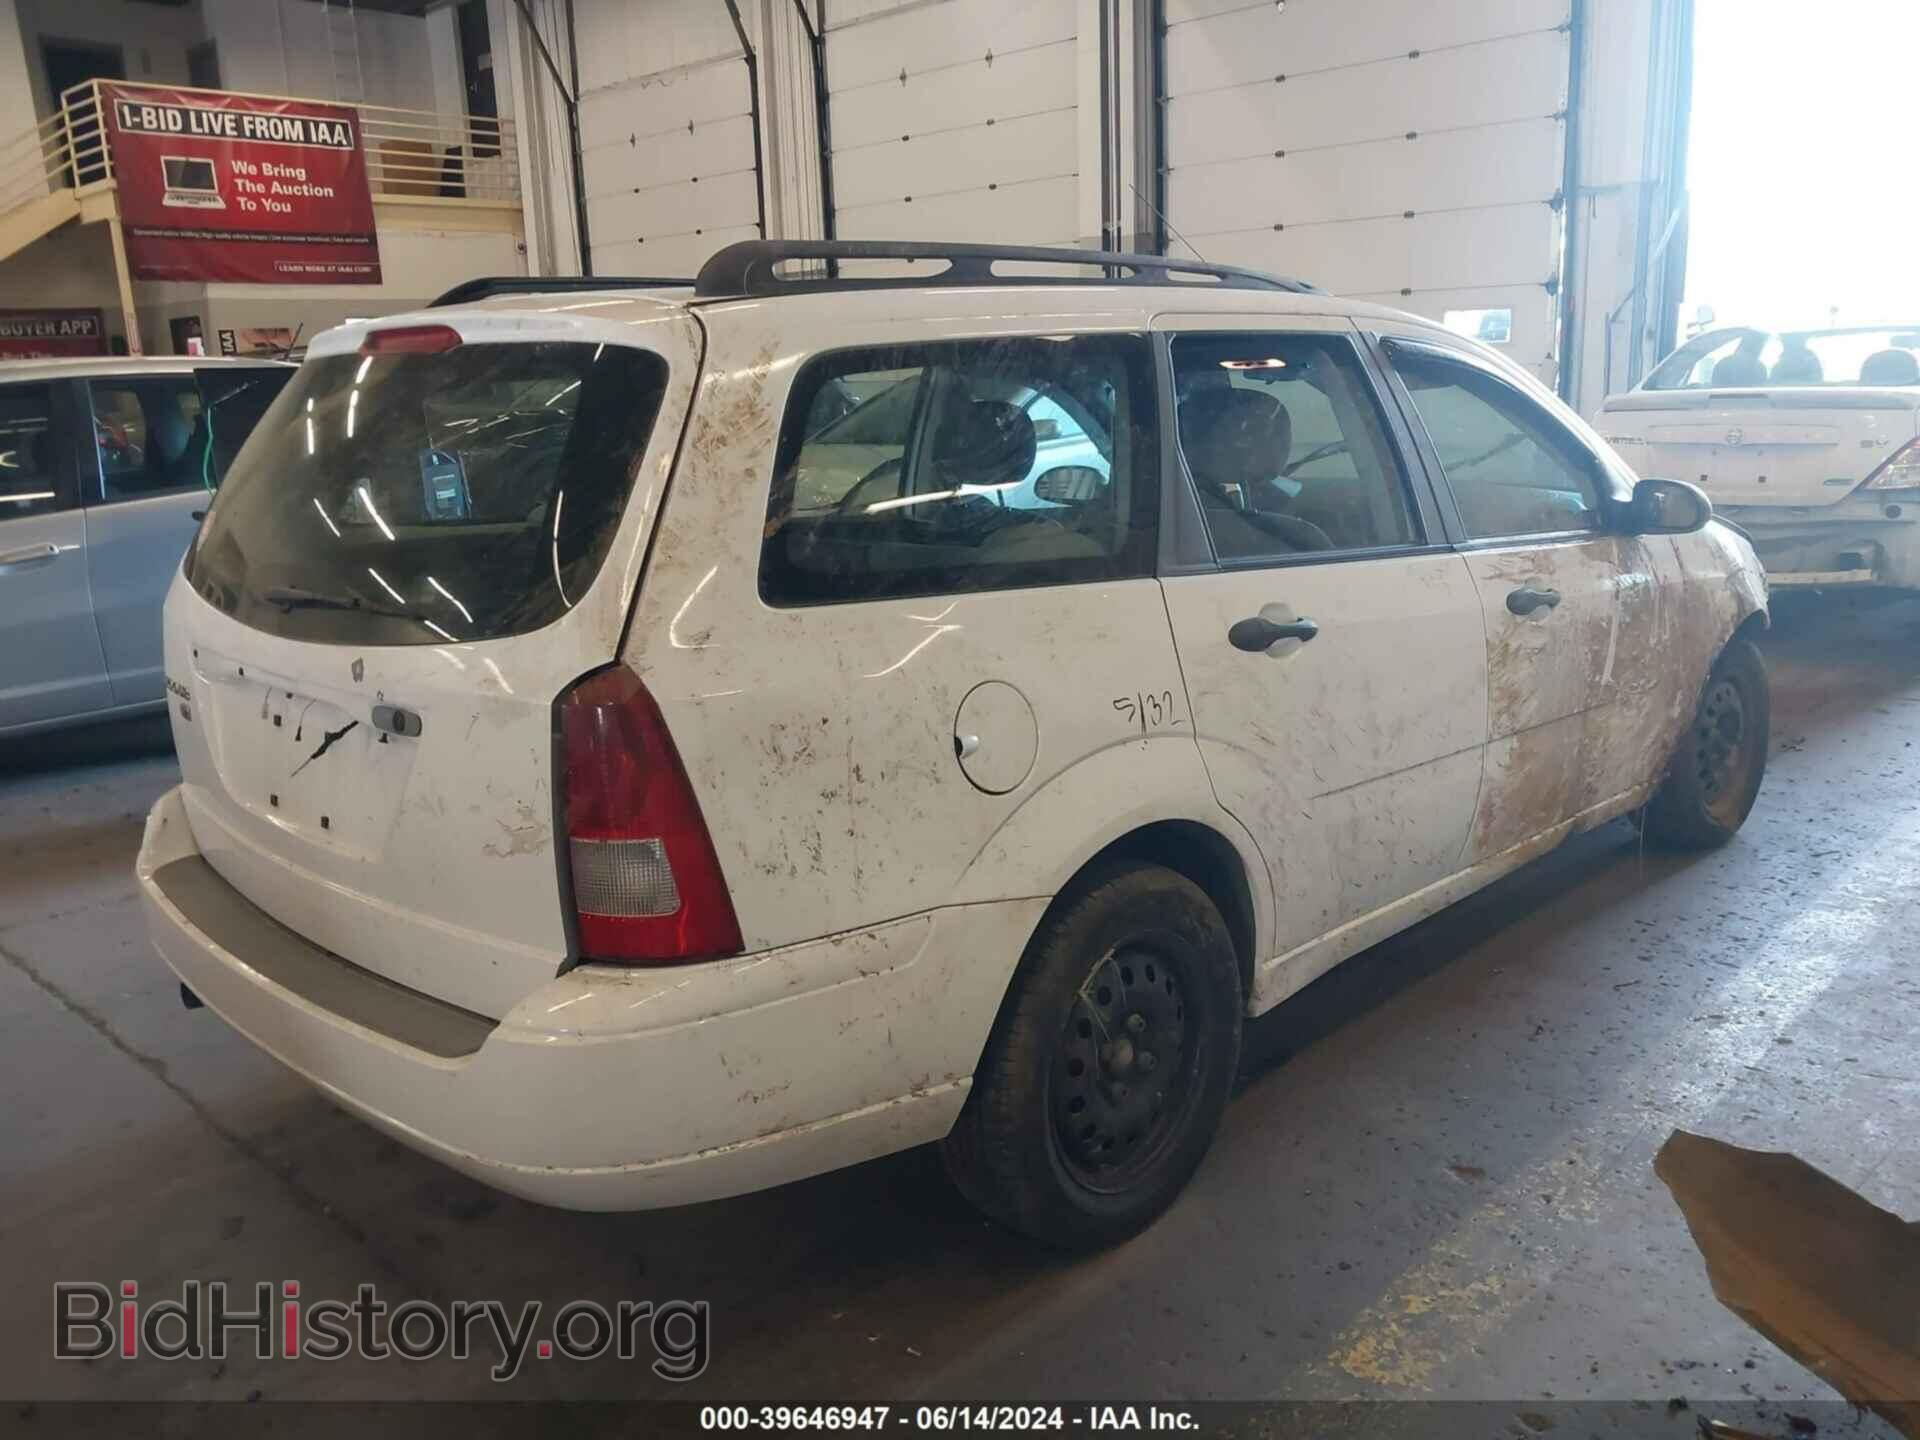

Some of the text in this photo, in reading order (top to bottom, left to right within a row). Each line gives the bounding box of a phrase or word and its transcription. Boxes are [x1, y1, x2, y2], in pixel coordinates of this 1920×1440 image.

[123, 105, 348, 145] I-BID LIVE FROM IAA
[231, 160, 306, 181] We Bring
[234, 178, 334, 198] The Auction
[236, 196, 292, 213] To You
[60, 319, 91, 335] APP
